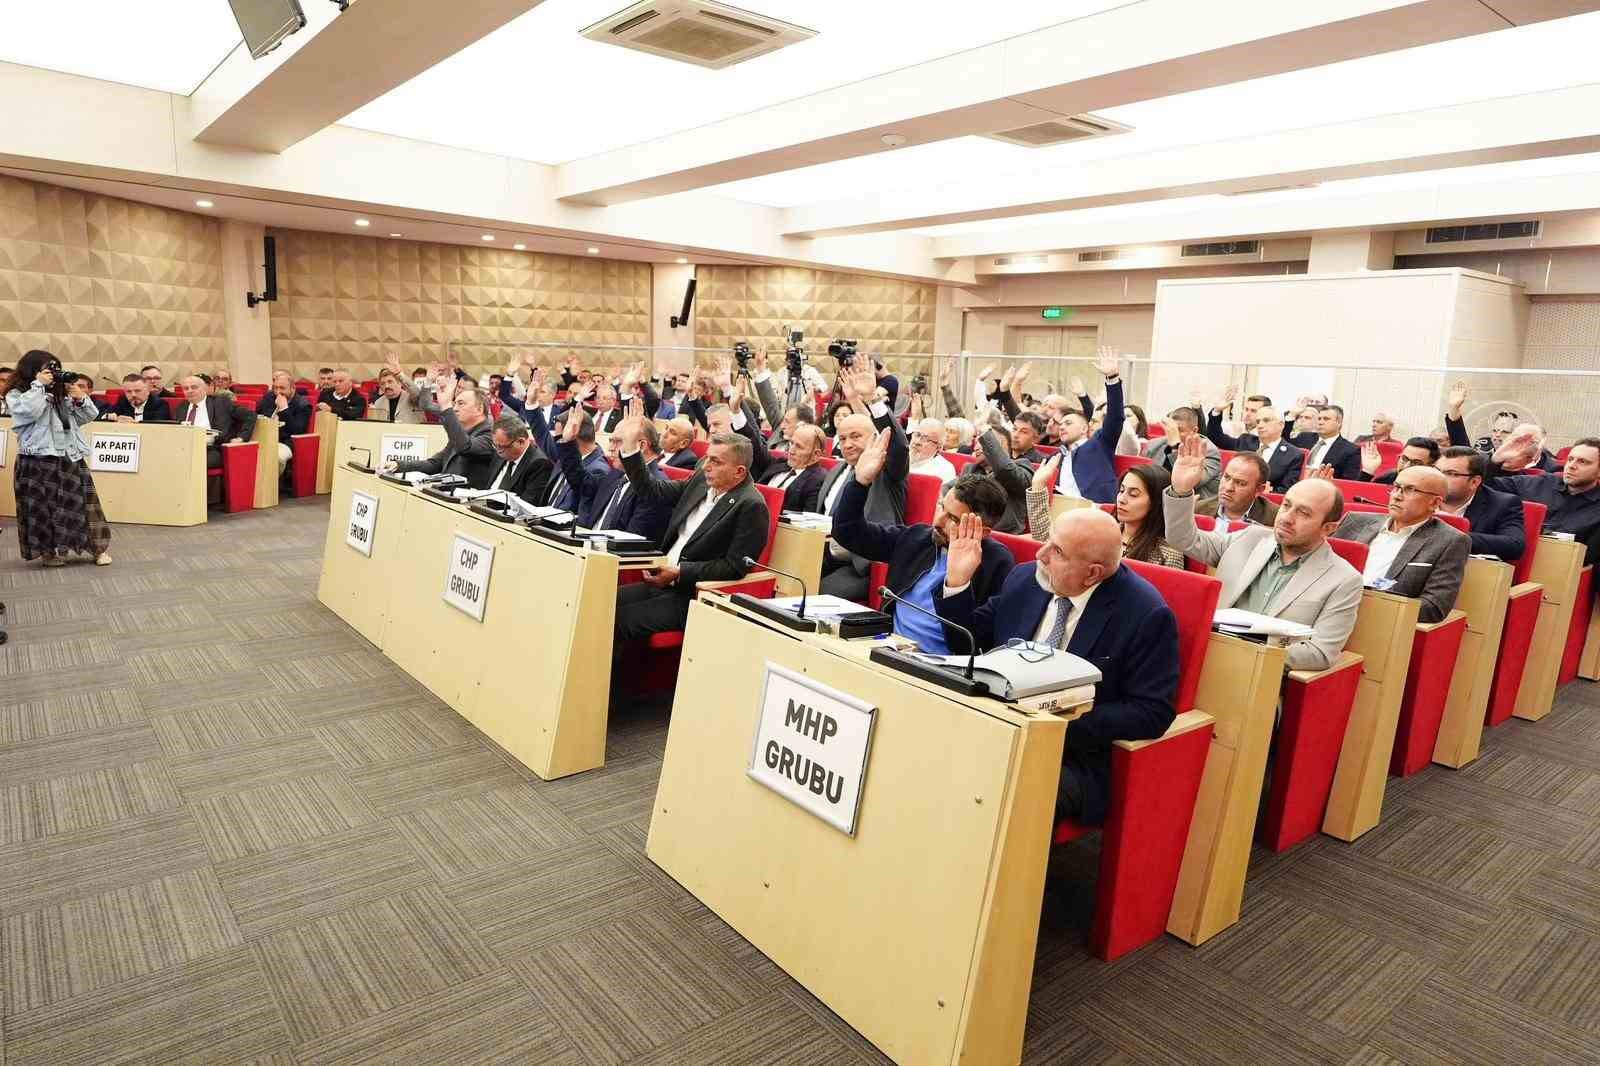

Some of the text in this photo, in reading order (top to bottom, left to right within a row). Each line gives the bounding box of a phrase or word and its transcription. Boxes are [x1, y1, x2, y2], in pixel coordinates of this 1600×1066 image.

[95, 440, 136, 450] AK PARTİ
[394, 441, 413, 450] CHP
[99, 454, 130, 463] GRUBU
[356, 502, 368, 517] CHP
[460, 548, 479, 570] CHP
[450, 574, 480, 603] GRUBU
[784, 698, 838, 745] MHP
[765, 740, 844, 805] GRUBU
